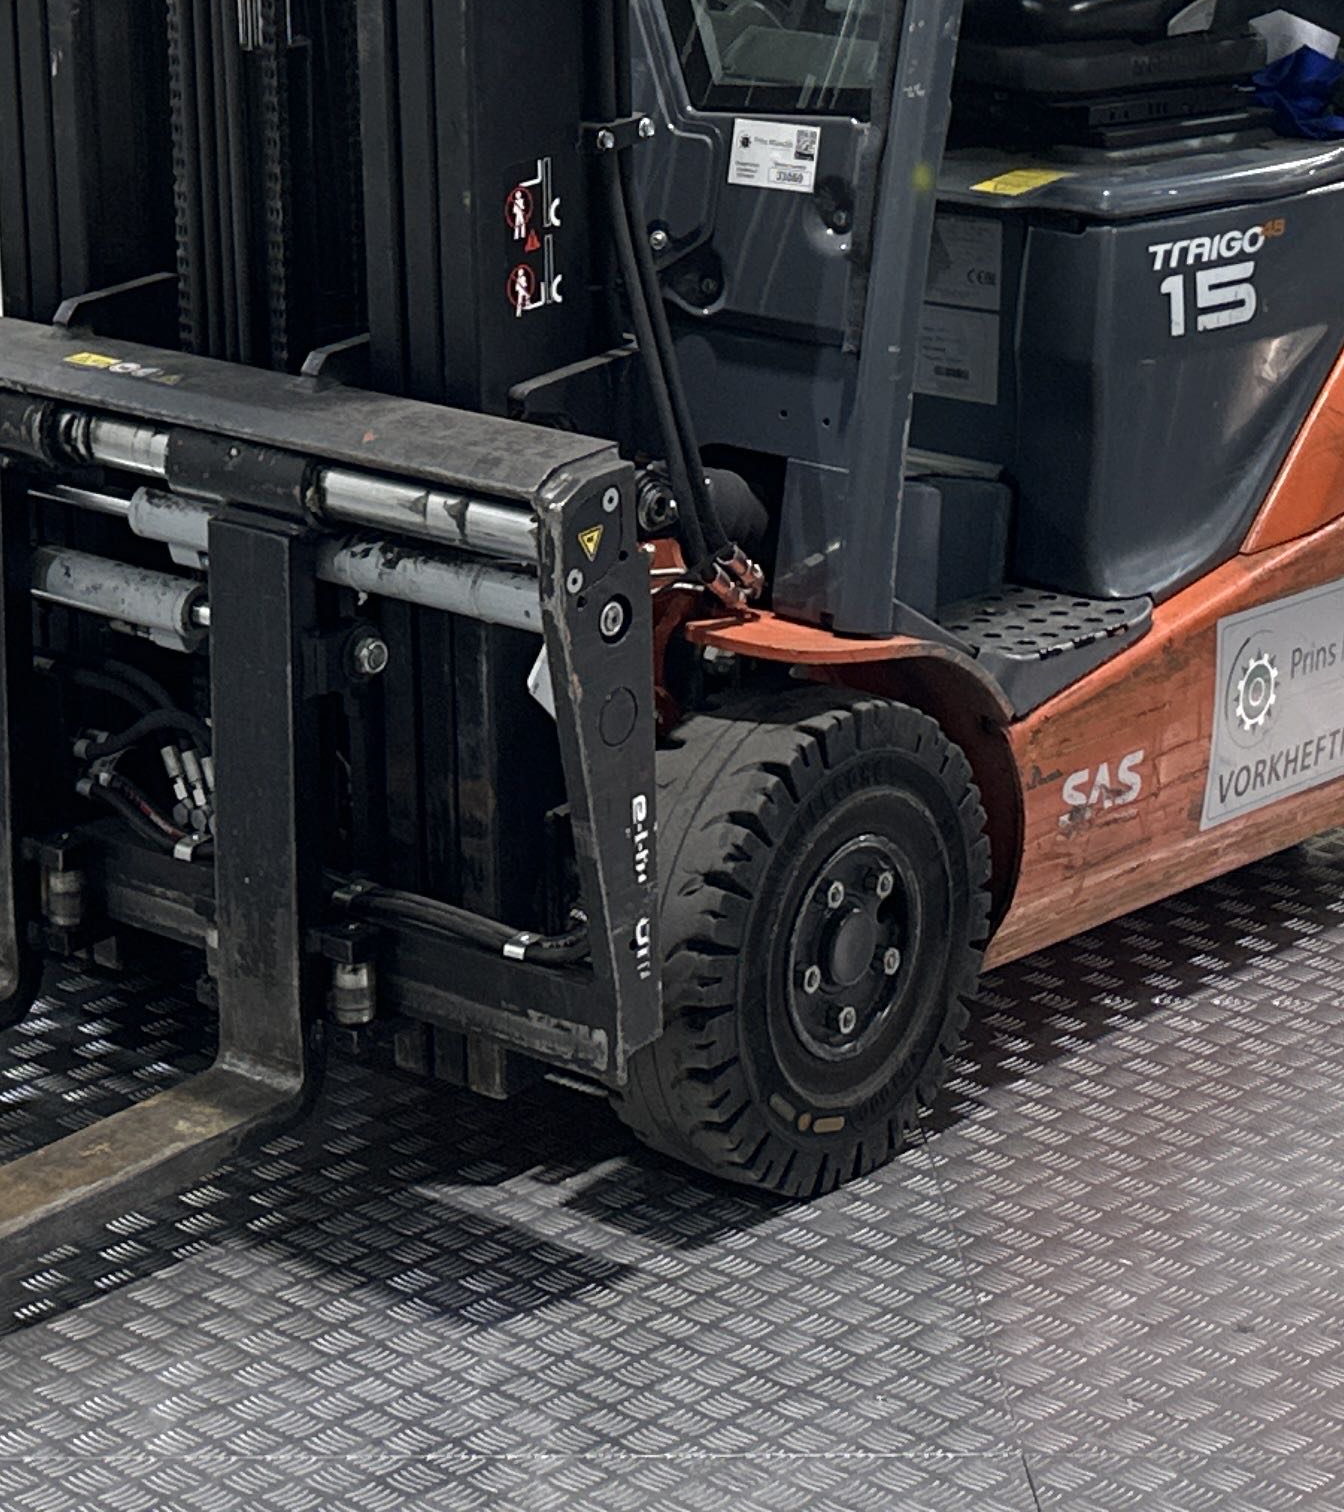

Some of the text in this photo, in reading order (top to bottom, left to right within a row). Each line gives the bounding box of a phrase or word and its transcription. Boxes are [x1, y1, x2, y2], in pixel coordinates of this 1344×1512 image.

[1149, 226, 1265, 271] TRAIGO
[1160, 261, 1257, 337] 15
[1290, 641, 1337, 679] Prins
